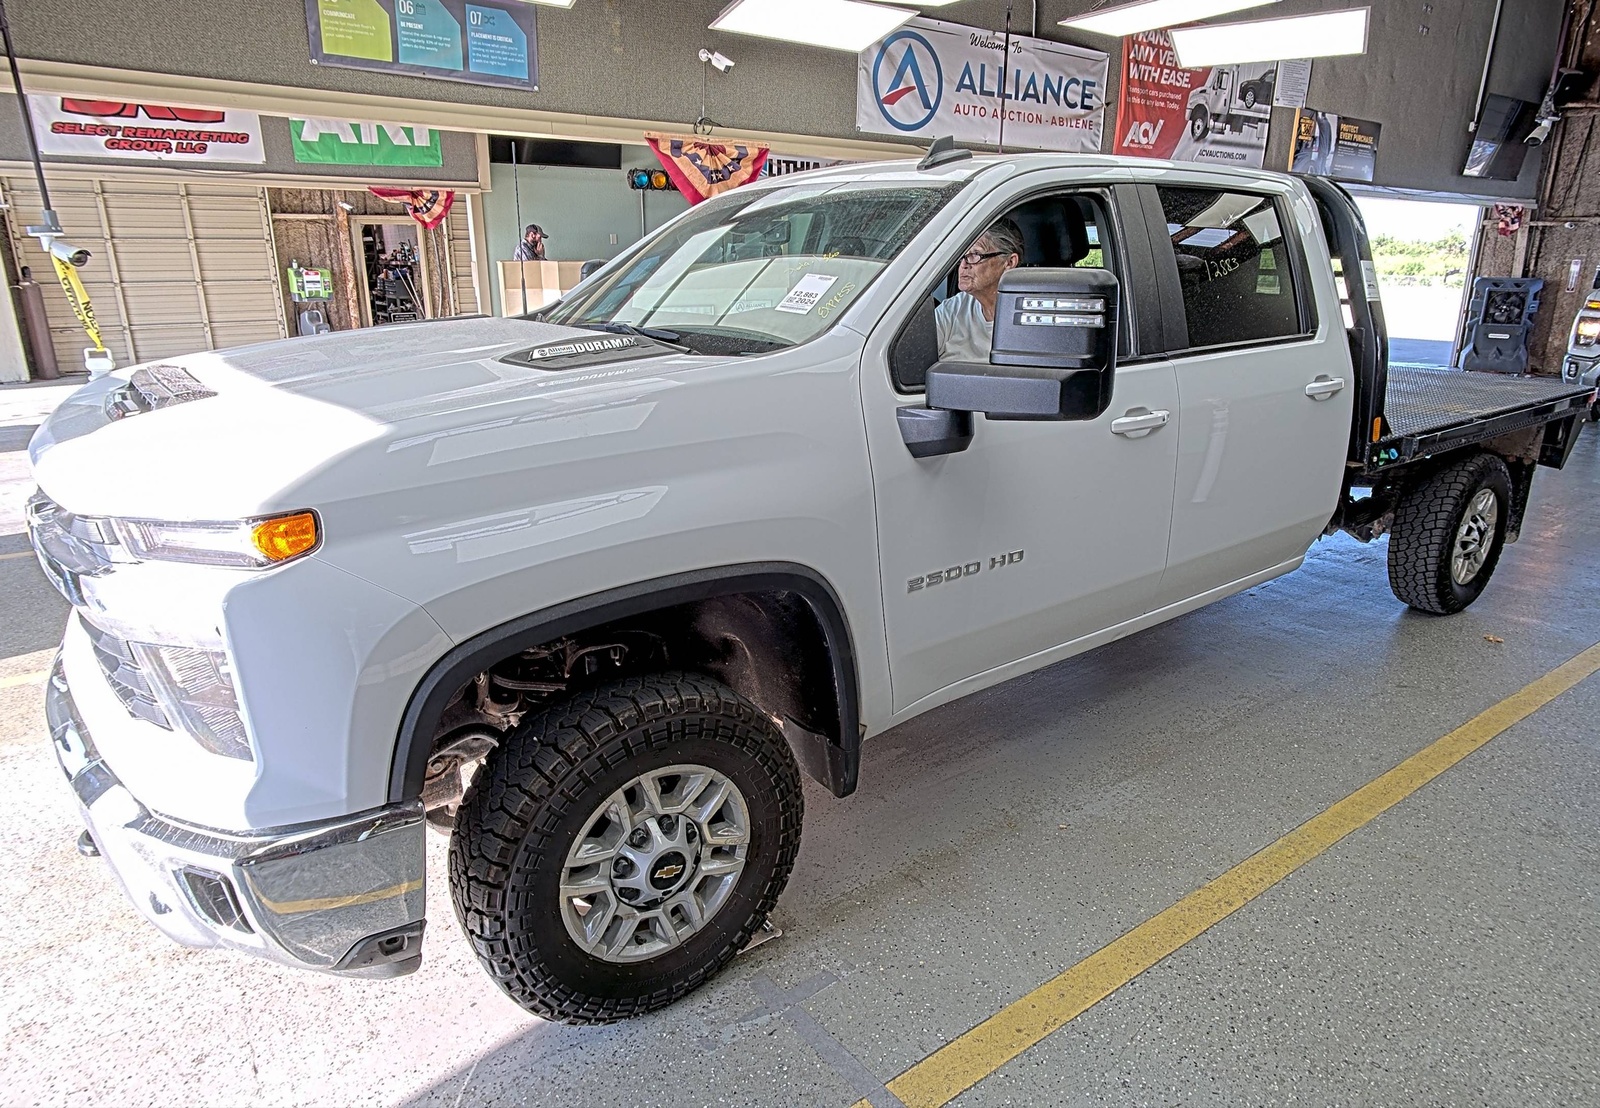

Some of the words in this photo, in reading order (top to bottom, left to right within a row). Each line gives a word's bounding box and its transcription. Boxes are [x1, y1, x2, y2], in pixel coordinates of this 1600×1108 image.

[323, 10, 355, 19] COMMUNICATE
[399, 0, 414, 15] 06
[406, 21, 424, 30] PRESENT
[470, 11, 481, 25] 07
[497, 35, 513, 43] CRITICAL
[1012, 41, 1023, 54] To
[1129, 44, 1157, 63] ANY
[1129, 62, 1161, 83] WITH
[1160, 68, 1191, 88] EASE.
[955, 60, 1097, 111] ALLIANCE
[1127, 85, 1149, 95] Transport
[1158, 91, 1182, 100] purchased
[1131, 96, 1140, 104] this
[1146, 99, 1155, 108] any
[1166, 101, 1180, 110] Today.
[953, 103, 987, 118] AUTO
[992, 108, 1042, 124] AUCTION
[1050, 115, 1094, 131] ABILENE
[52, 122, 121, 136] SELECT
[122, 125, 249, 143] REMARKETING
[1122, 119, 1165, 147] ACV
[1341, 123, 1359, 133] PROTECT
[1340, 131, 1353, 140] EVERY
[1353, 134, 1374, 144] PURCHASE
[104, 138, 173, 154] GROUP,
[175, 141, 208, 155] LLC
[1199, 148, 1248, 161] ACVAUCTIONS.COM
[1204, 256, 1240, 282] 12883
[795, 297, 816, 306] 2024
[575, 337, 639, 354] DURAMAX
[906, 560, 981, 594] 2500
[988, 548, 1025, 571] HD
